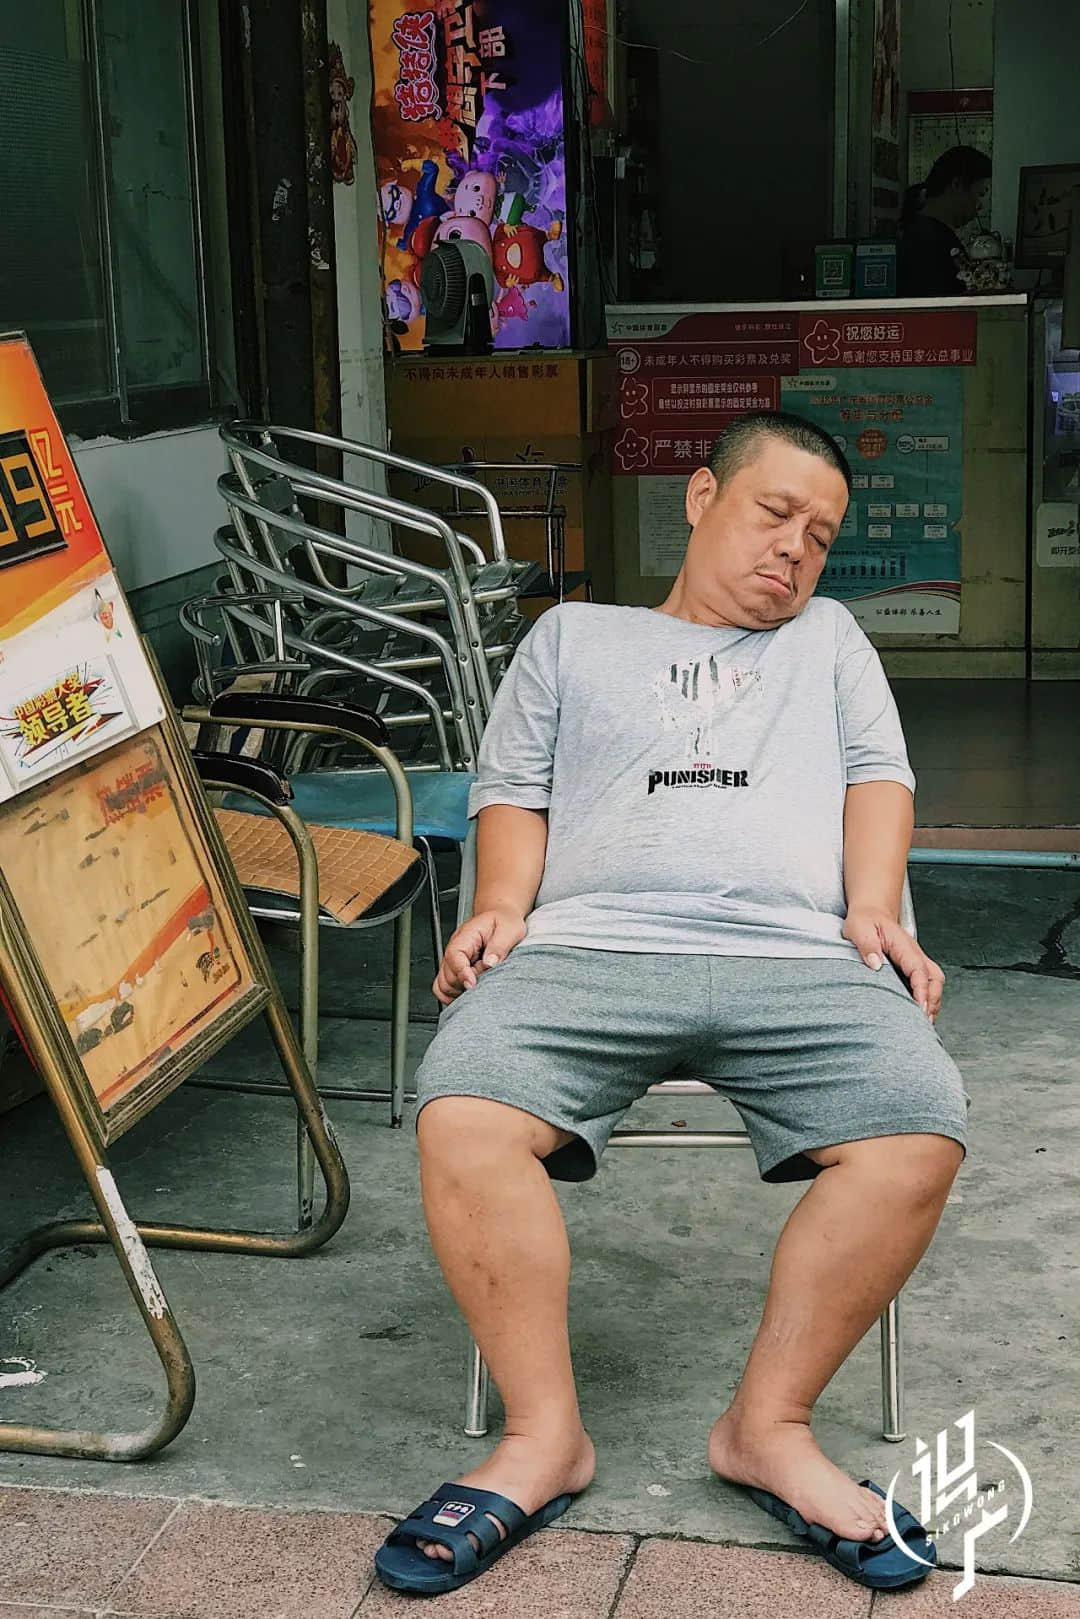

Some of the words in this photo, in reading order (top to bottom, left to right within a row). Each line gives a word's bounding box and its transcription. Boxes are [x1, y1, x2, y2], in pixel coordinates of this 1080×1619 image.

[392, 10, 438, 121] 猪猪侠
[846, 325, 902, 342] 祝您好运
[643, 352, 793, 368] 未成年人不得购买彩票及兑奖
[842, 349, 974, 365] 感谢您支持国家公益事业
[406, 364, 560, 380] 不得向未成年人销售彩票
[18, 690, 96, 748] 领导者
[647, 769, 749, 795] PUNISHER
